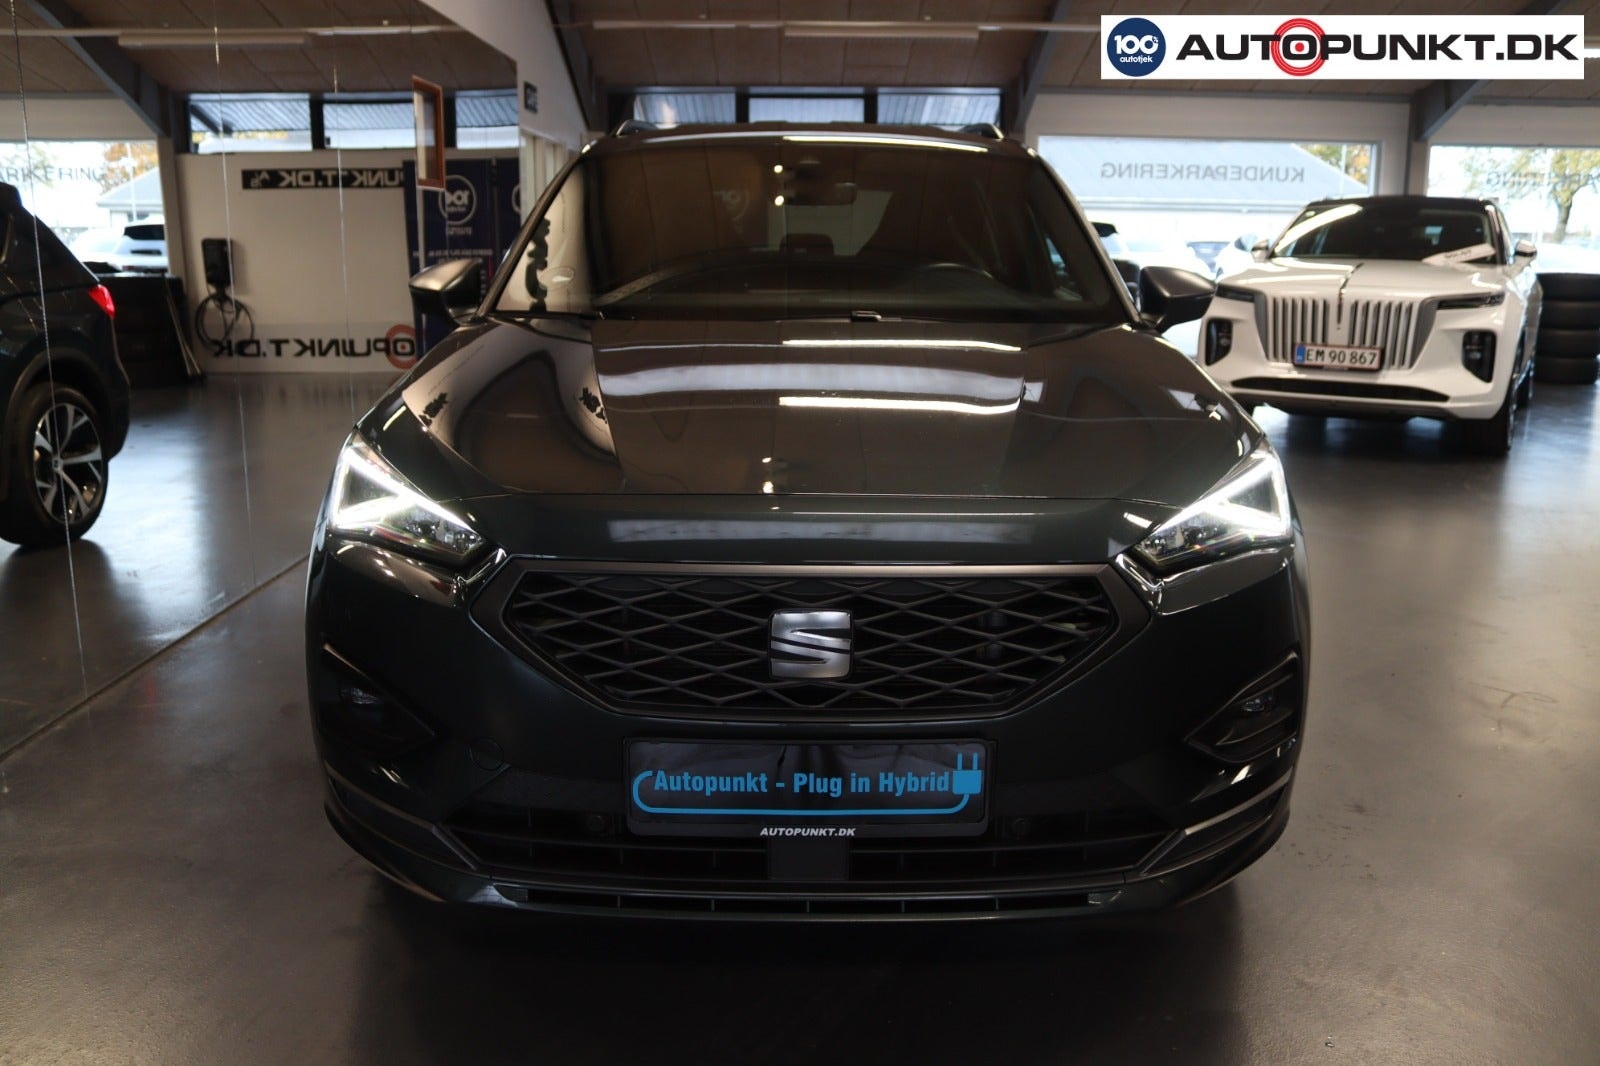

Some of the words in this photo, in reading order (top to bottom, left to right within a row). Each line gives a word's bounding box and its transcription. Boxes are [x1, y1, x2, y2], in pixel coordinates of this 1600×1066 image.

[1306, 348, 1325, 362] EM
[1328, 350, 1346, 364] 90
[1349, 351, 1377, 365] 867
[654, 770, 768, 795] Autopunkt
[793, 773, 842, 798] Plug
[851, 773, 870, 793] in
[879, 772, 949, 797] Hybrid
[760, 828, 856, 837] AUTOPUNKT.DK
